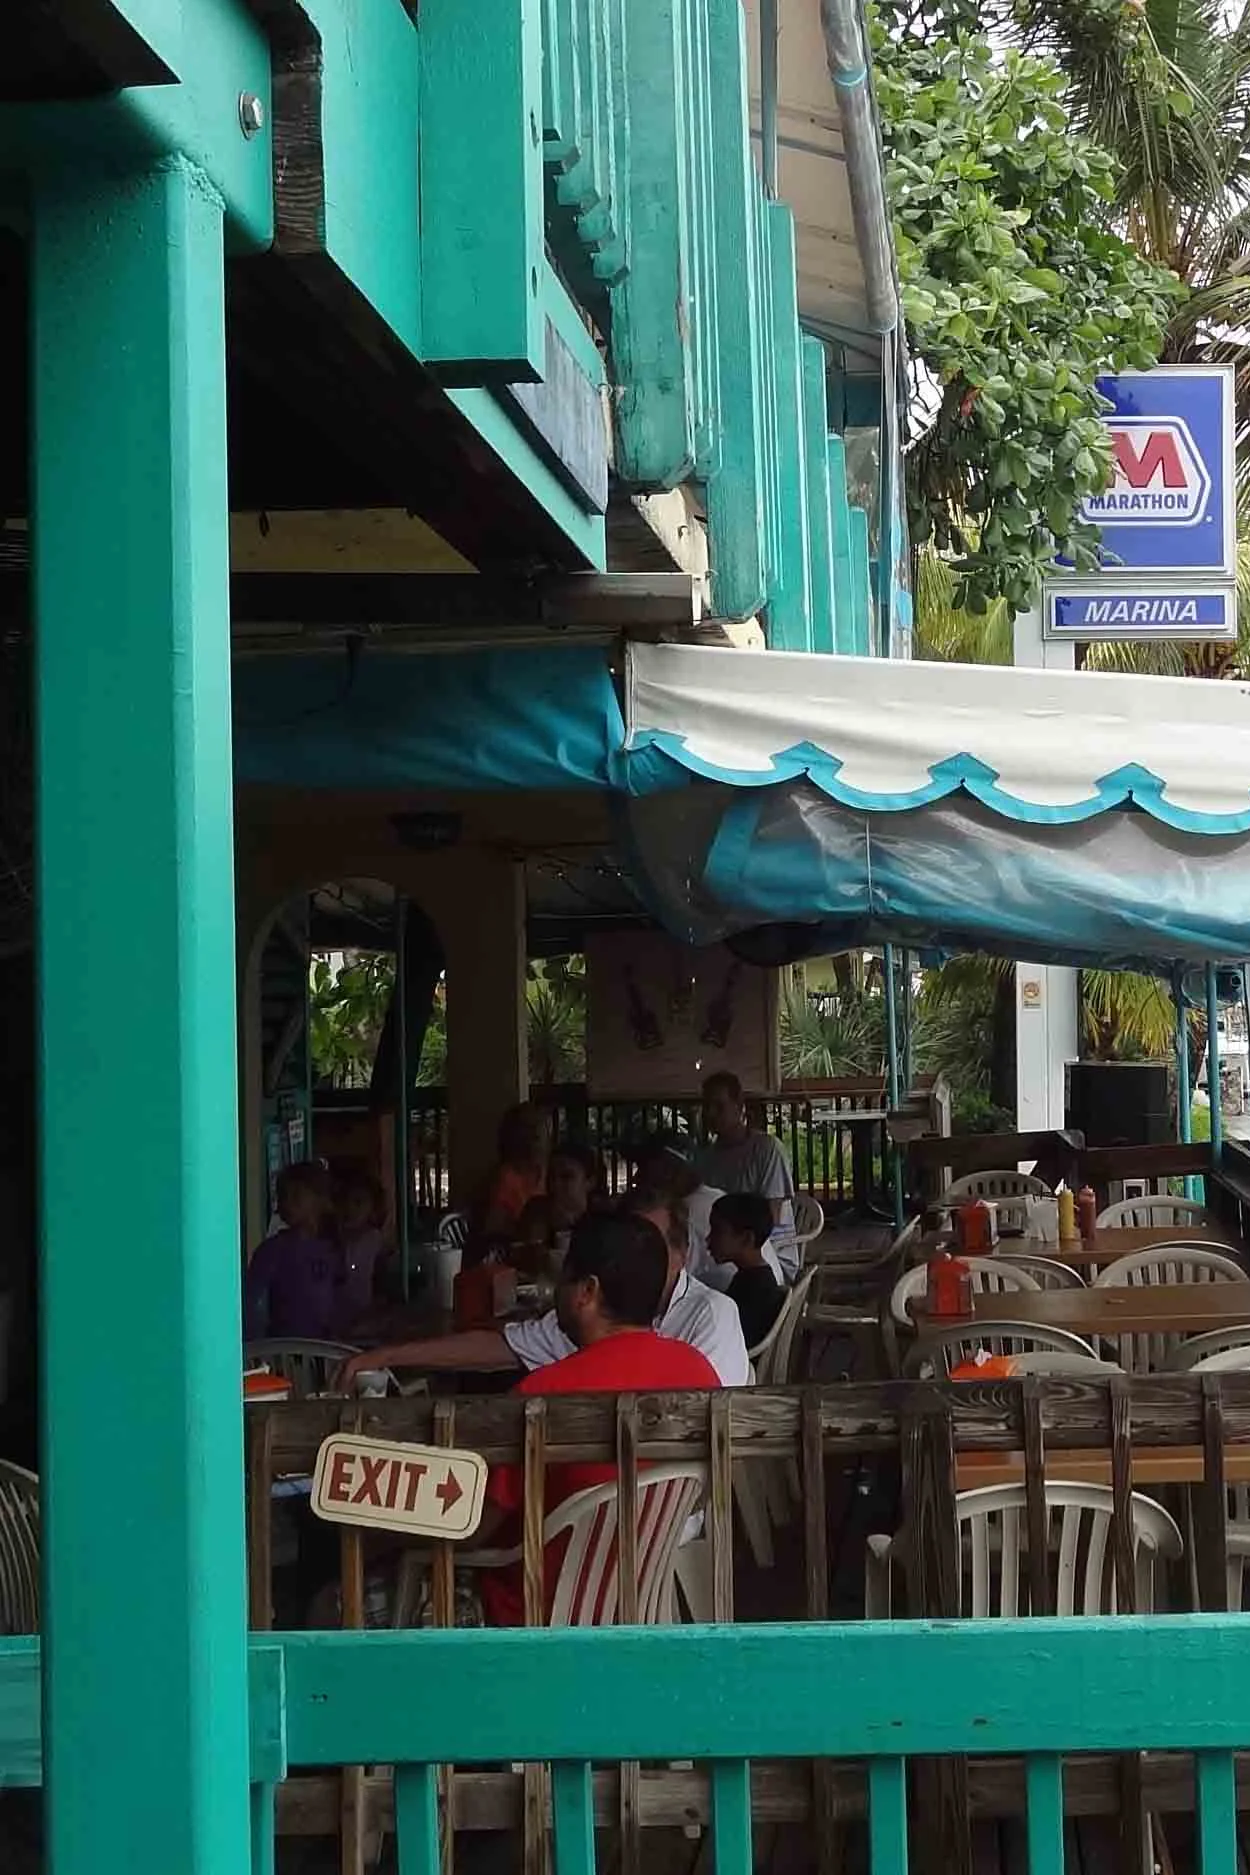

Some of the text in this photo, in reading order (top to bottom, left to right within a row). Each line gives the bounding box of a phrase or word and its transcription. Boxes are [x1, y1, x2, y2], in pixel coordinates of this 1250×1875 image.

[1105, 431, 1188, 489] M
[1088, 493, 1189, 510] MARATHON
[1084, 600, 1198, 622] MARINA
[327, 1451, 428, 1512] EXIT
